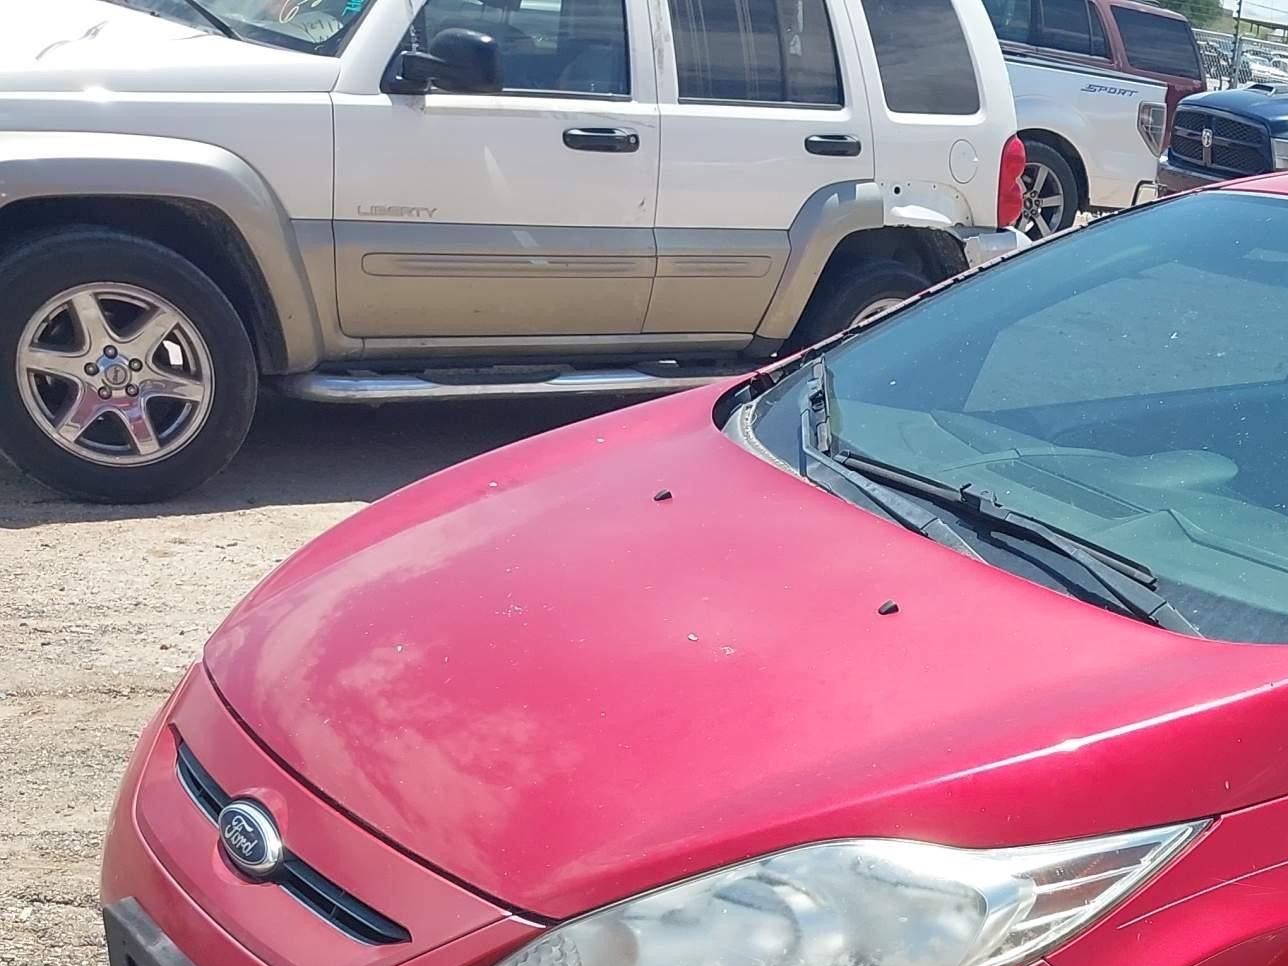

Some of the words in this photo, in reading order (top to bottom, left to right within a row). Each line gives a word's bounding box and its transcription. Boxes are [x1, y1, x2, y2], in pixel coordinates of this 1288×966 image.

[1080, 84, 1139, 96] SPORT
[357, 205, 438, 218] LIBERTY
[225, 816, 258, 856] Ford
